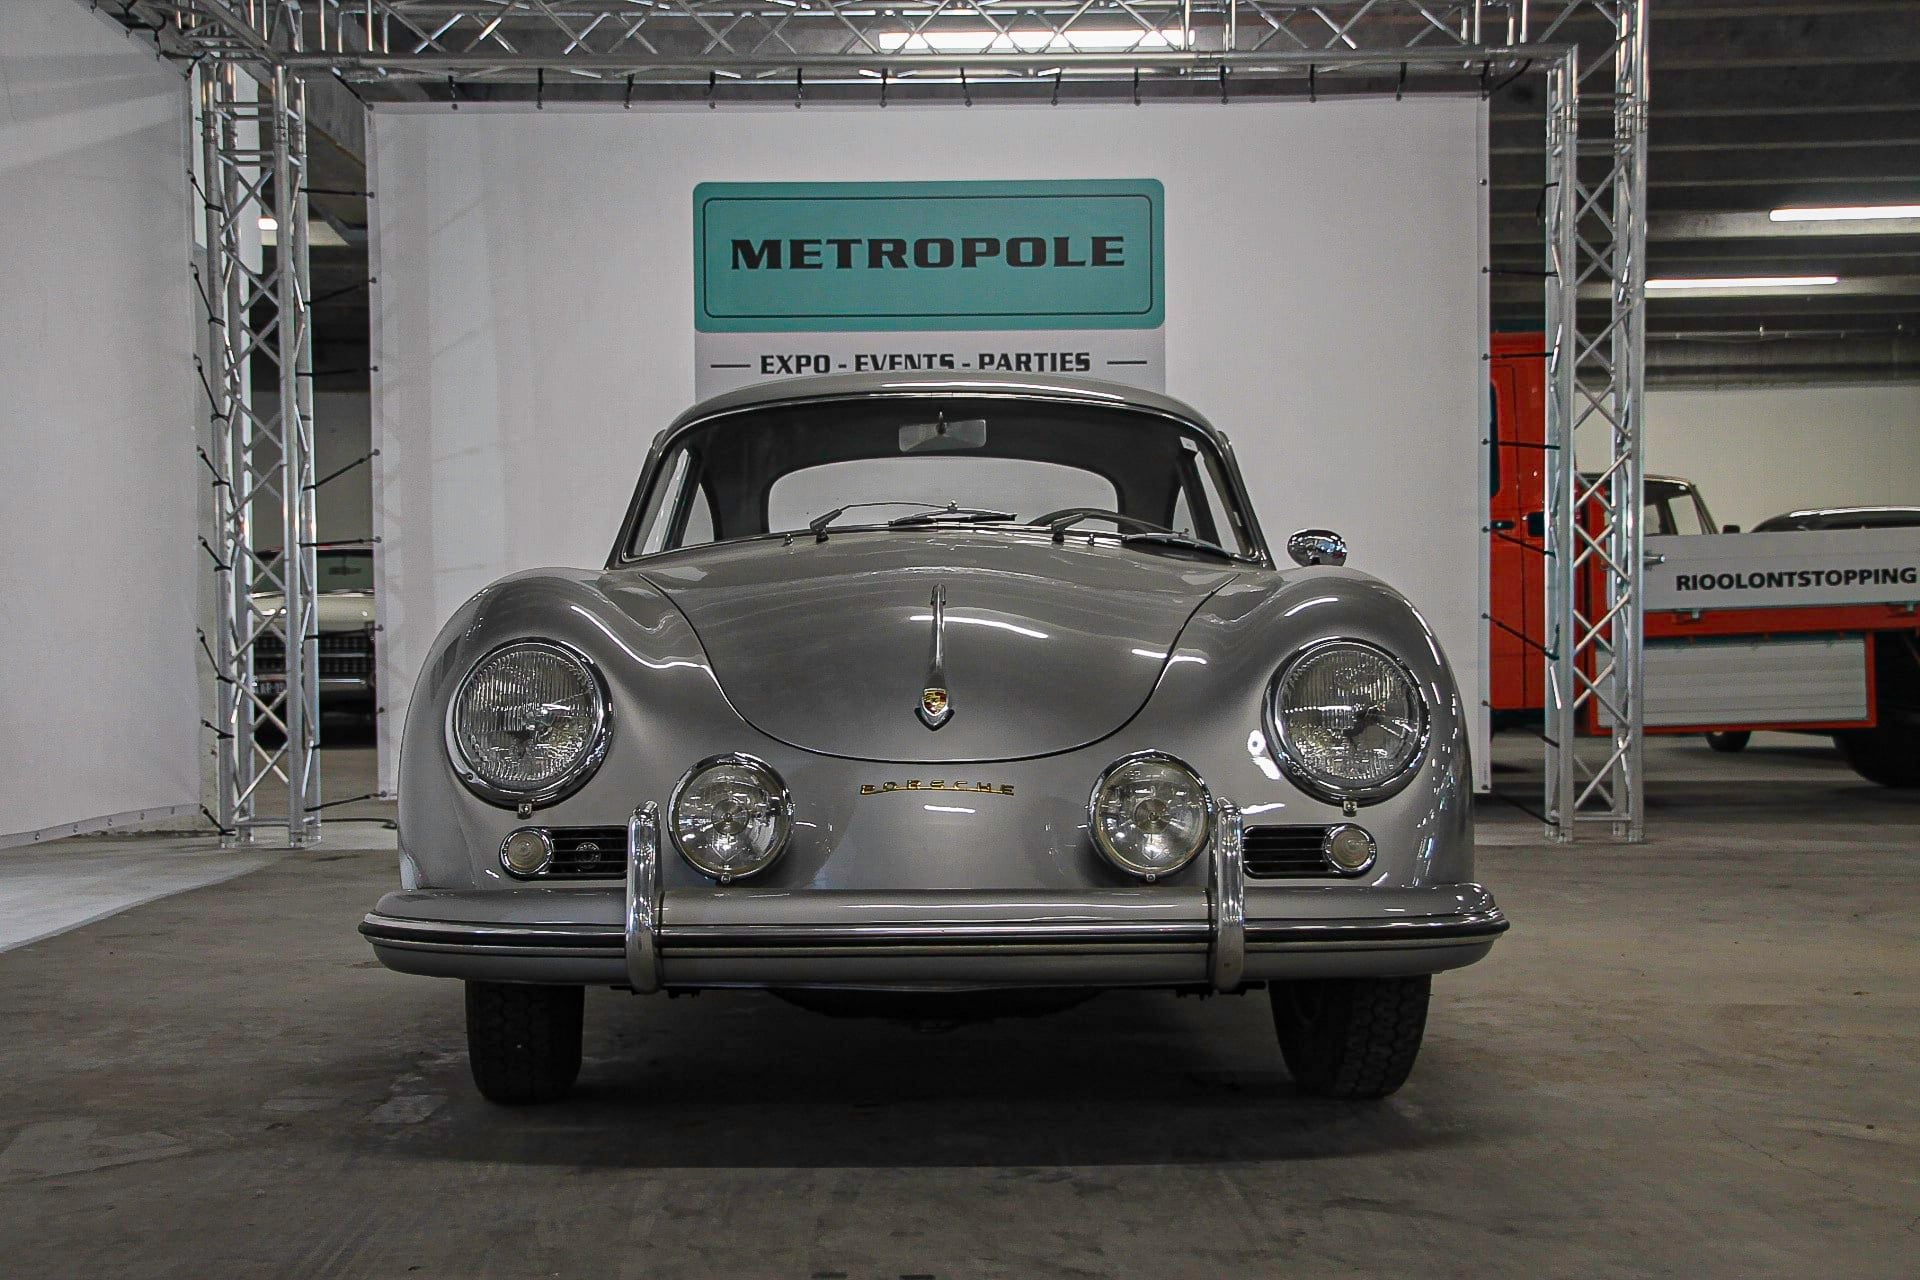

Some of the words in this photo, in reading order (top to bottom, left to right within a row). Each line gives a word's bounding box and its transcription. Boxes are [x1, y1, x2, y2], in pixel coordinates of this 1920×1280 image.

[731, 235, 1125, 270] METROPOLE
[760, 354, 831, 375] EXPO
[855, 353, 954, 372] EVENTS
[978, 352, 1091, 372] PARTIES
[1676, 567, 1917, 591] RIOOLONTSTOPPING
[860, 779, 1015, 796] PORSCHE
